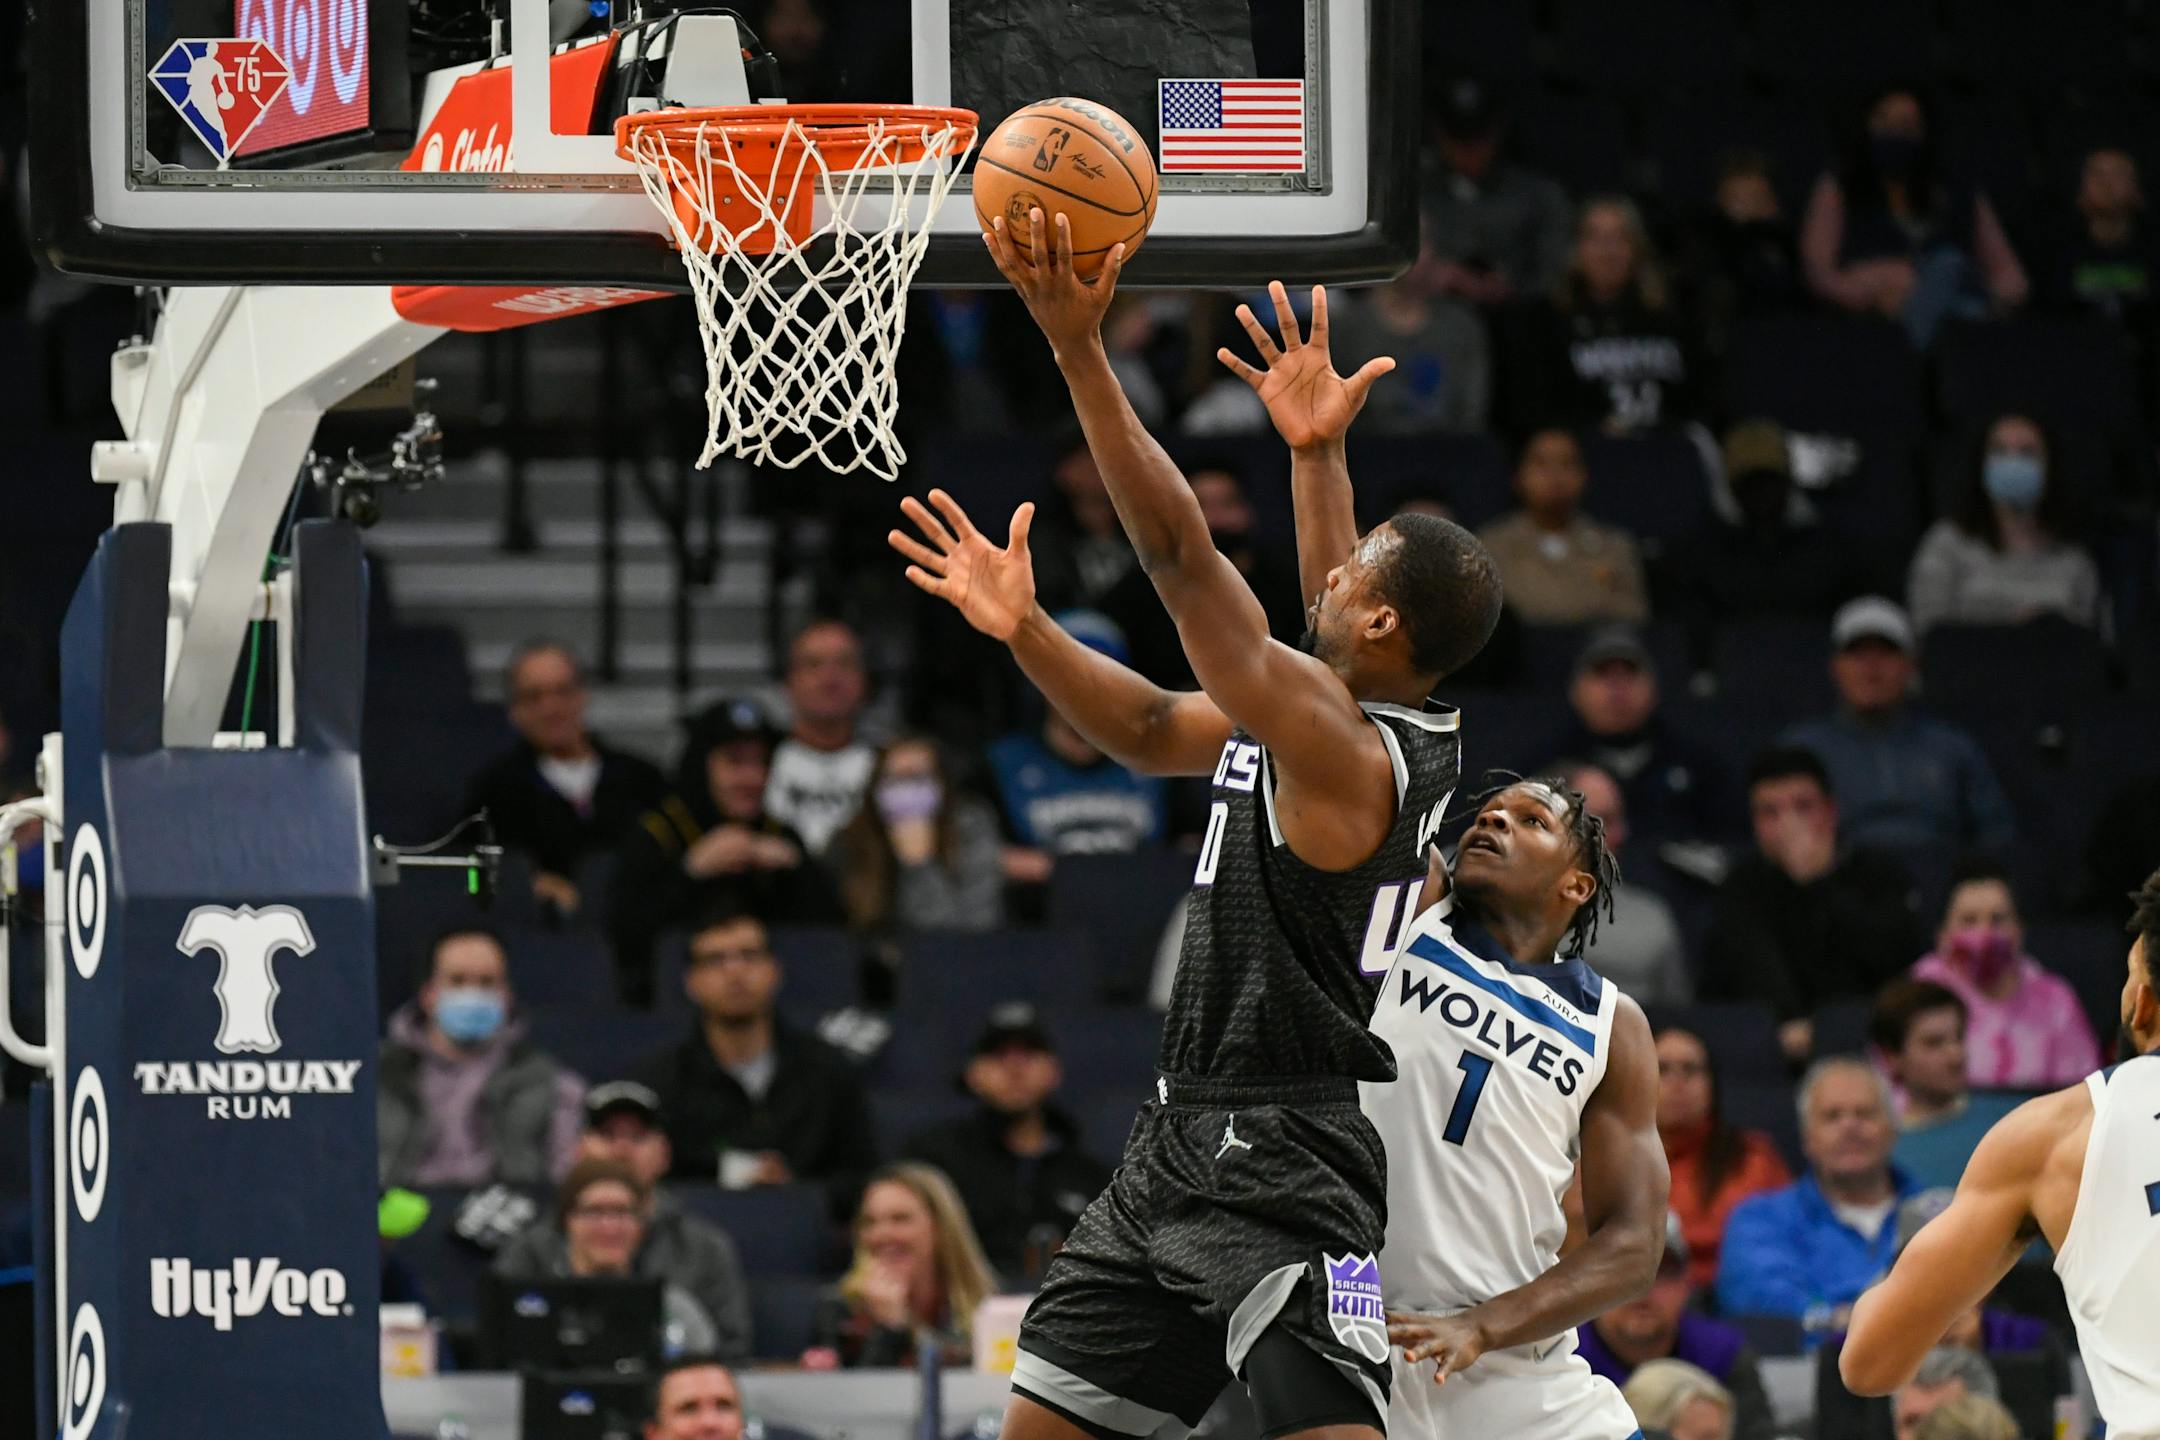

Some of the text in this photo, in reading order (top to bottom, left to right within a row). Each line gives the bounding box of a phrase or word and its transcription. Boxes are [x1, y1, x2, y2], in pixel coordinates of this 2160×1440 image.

[234, 57, 260, 92] 75
[1400, 969, 1584, 1096] WOLVES
[133, 1060, 362, 1094] TANDUAY
[207, 1096, 291, 1119] RUM
[1442, 1049, 1494, 1146] 1
